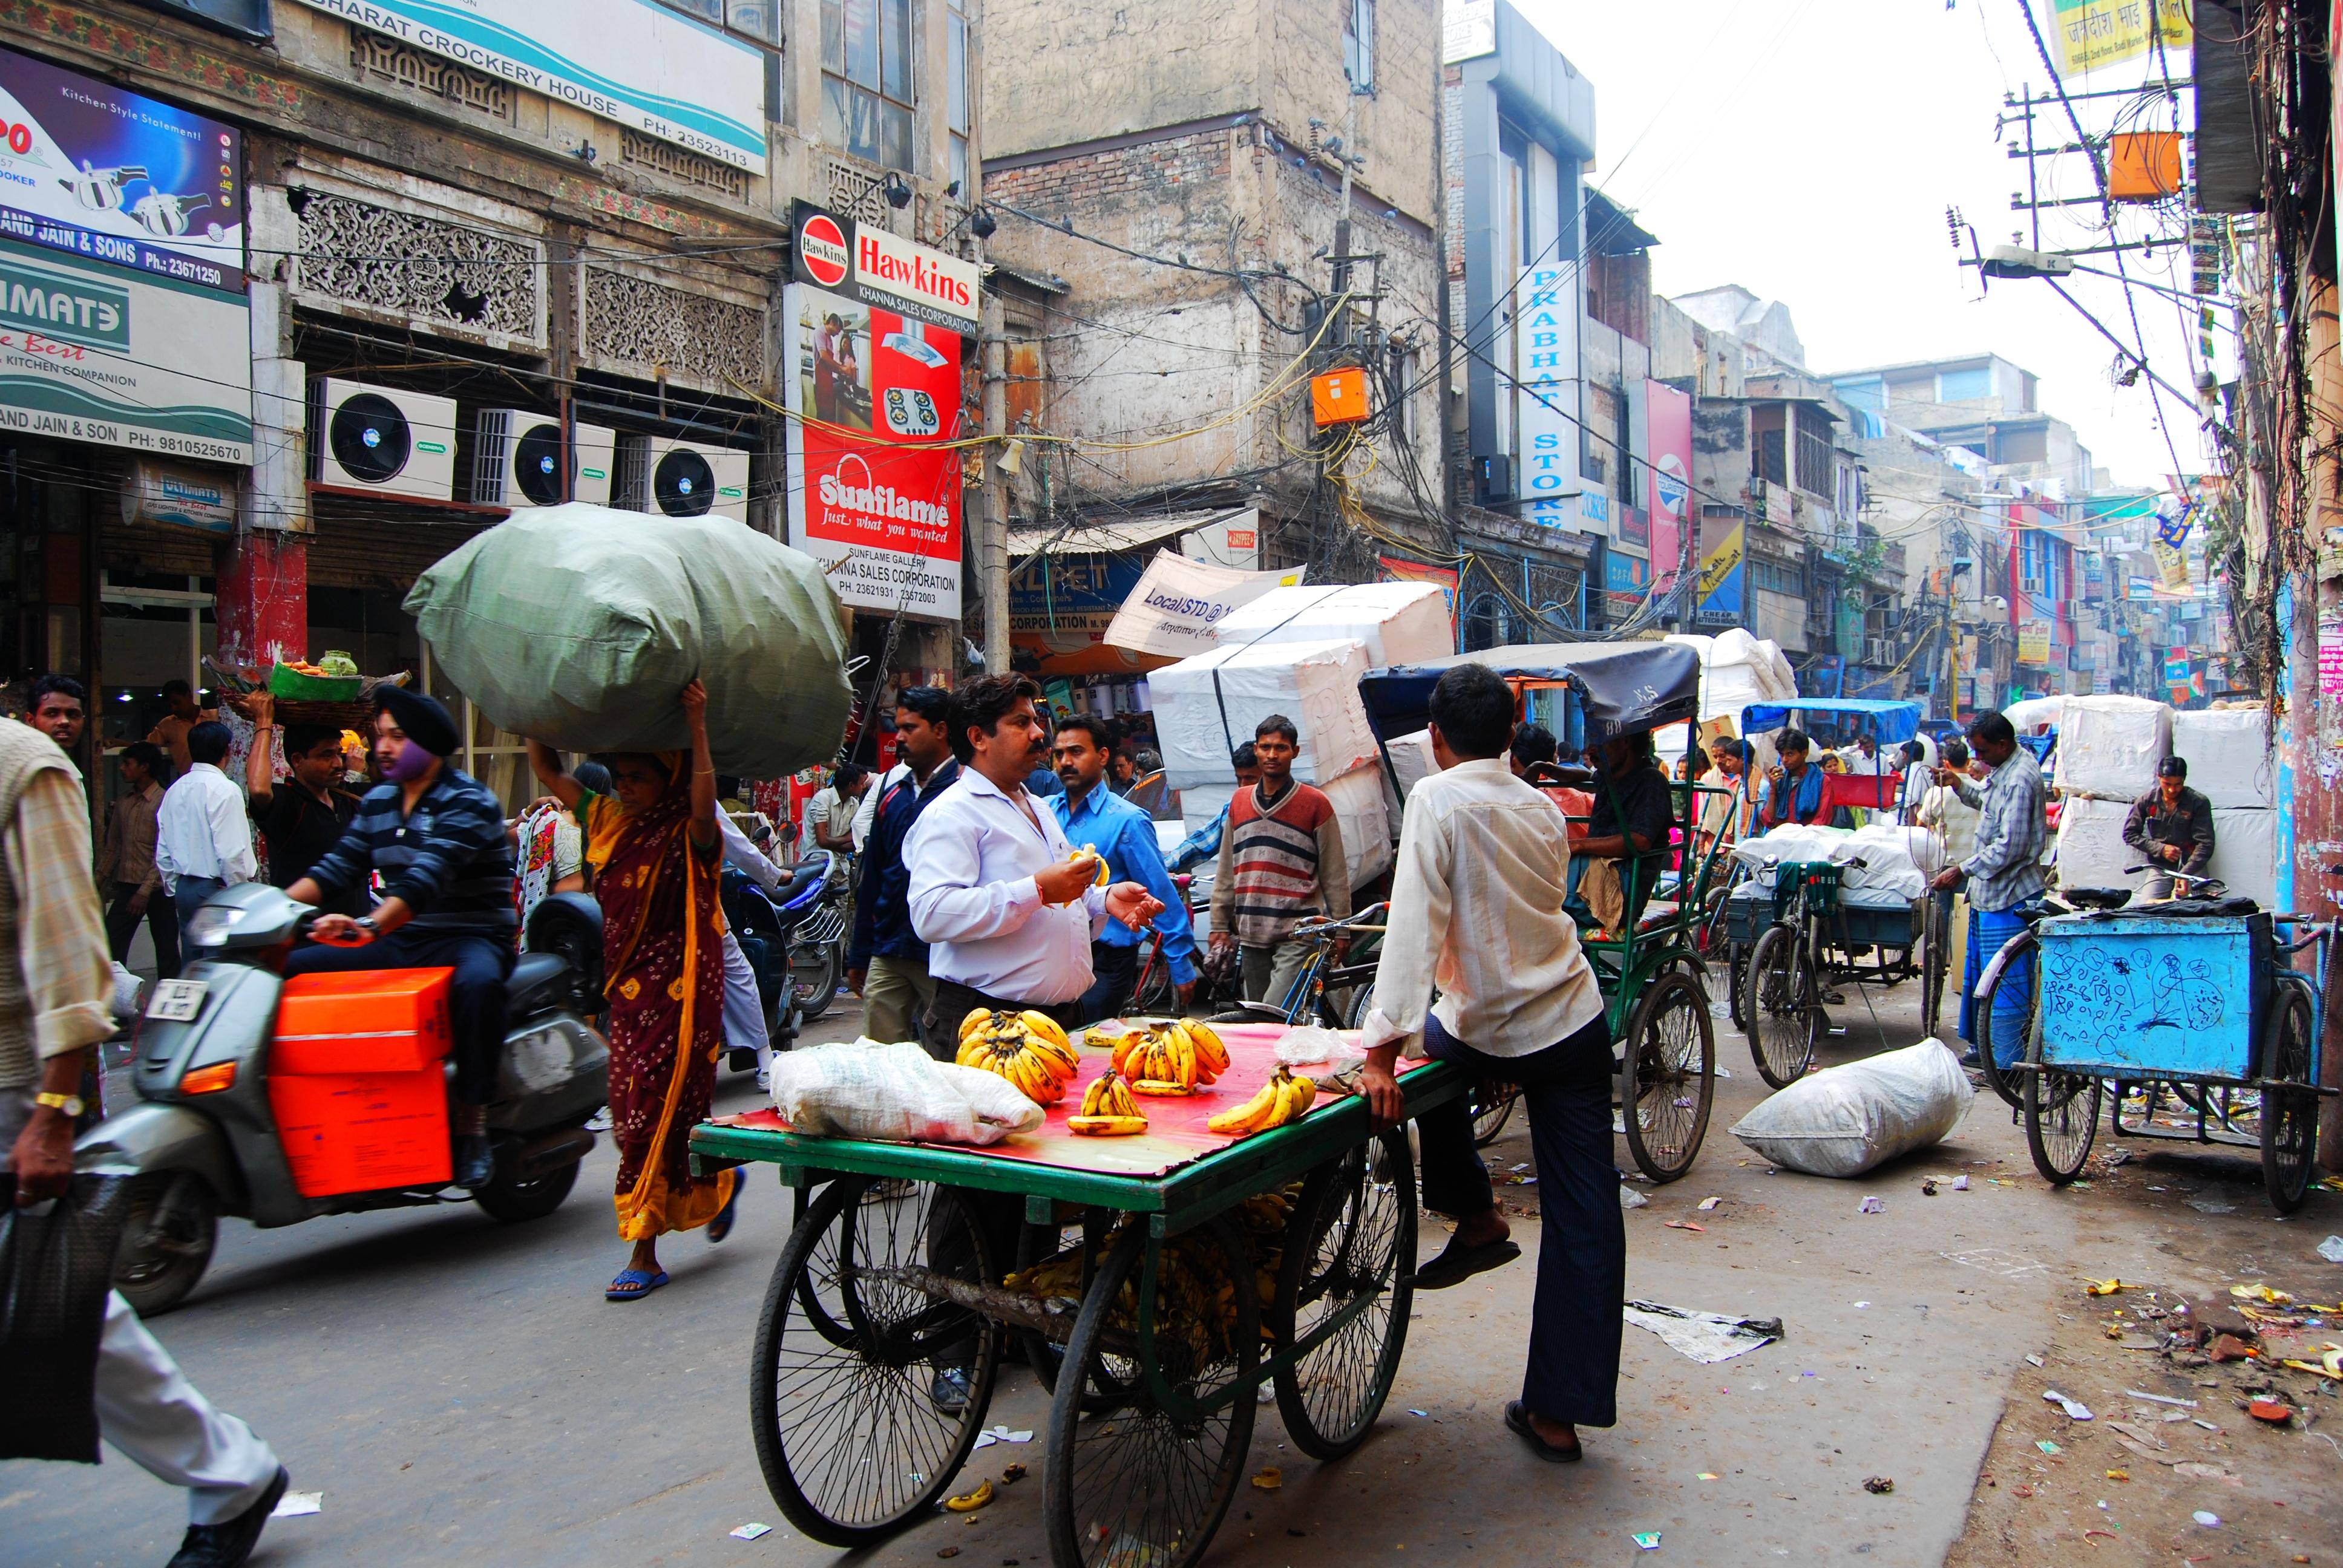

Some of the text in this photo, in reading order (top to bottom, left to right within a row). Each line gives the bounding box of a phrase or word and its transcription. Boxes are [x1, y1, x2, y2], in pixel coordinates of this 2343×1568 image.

[62, 87, 202, 142] Kitchen Style Statement!
[419, 30, 543, 88] CROCKERY
[549, 78, 618, 117] HOUSE
[643, 117, 672, 138] PH:
[677, 130, 747, 166] 23523113
[1, 209, 35, 237] AND
[38, 220, 76, 249] JAIN
[80, 232, 92, 252] &
[95, 235, 137, 264] SONS
[169, 257, 221, 286] 23671250
[802, 236, 847, 266] Hawkins
[415, 261, 436, 272] 1939
[859, 235, 971, 307] Hawkins
[859, 285, 976, 334] KHANNA SALES CORPORATION
[24, 332, 86, 362] Best
[1529, 270, 1561, 409] PRABHAT
[6, 354, 137, 388] KITCHEN COMPANION
[33, 414, 68, 436] JAIN
[72, 420, 83, 437] &
[87, 422, 118, 443] SON
[128, 431, 156, 449] PH:
[159, 436, 241, 462] 9810525670
[1531, 433, 1564, 529] STORE
[819, 472, 949, 528] Sunflame
[821, 508, 948, 544] Just what you wanted
[817, 557, 955, 592] HANNA SALES CORPORATION
[849, 547, 926, 567] SUNFLAME GALLERY
[839, 581, 854, 593] PH.
[856, 583, 894, 598] 23621931
[1144, 587, 1208, 618] Local/STD
[1205, 604, 1222, 622] @
[1011, 616, 1087, 630] CORPORATION
